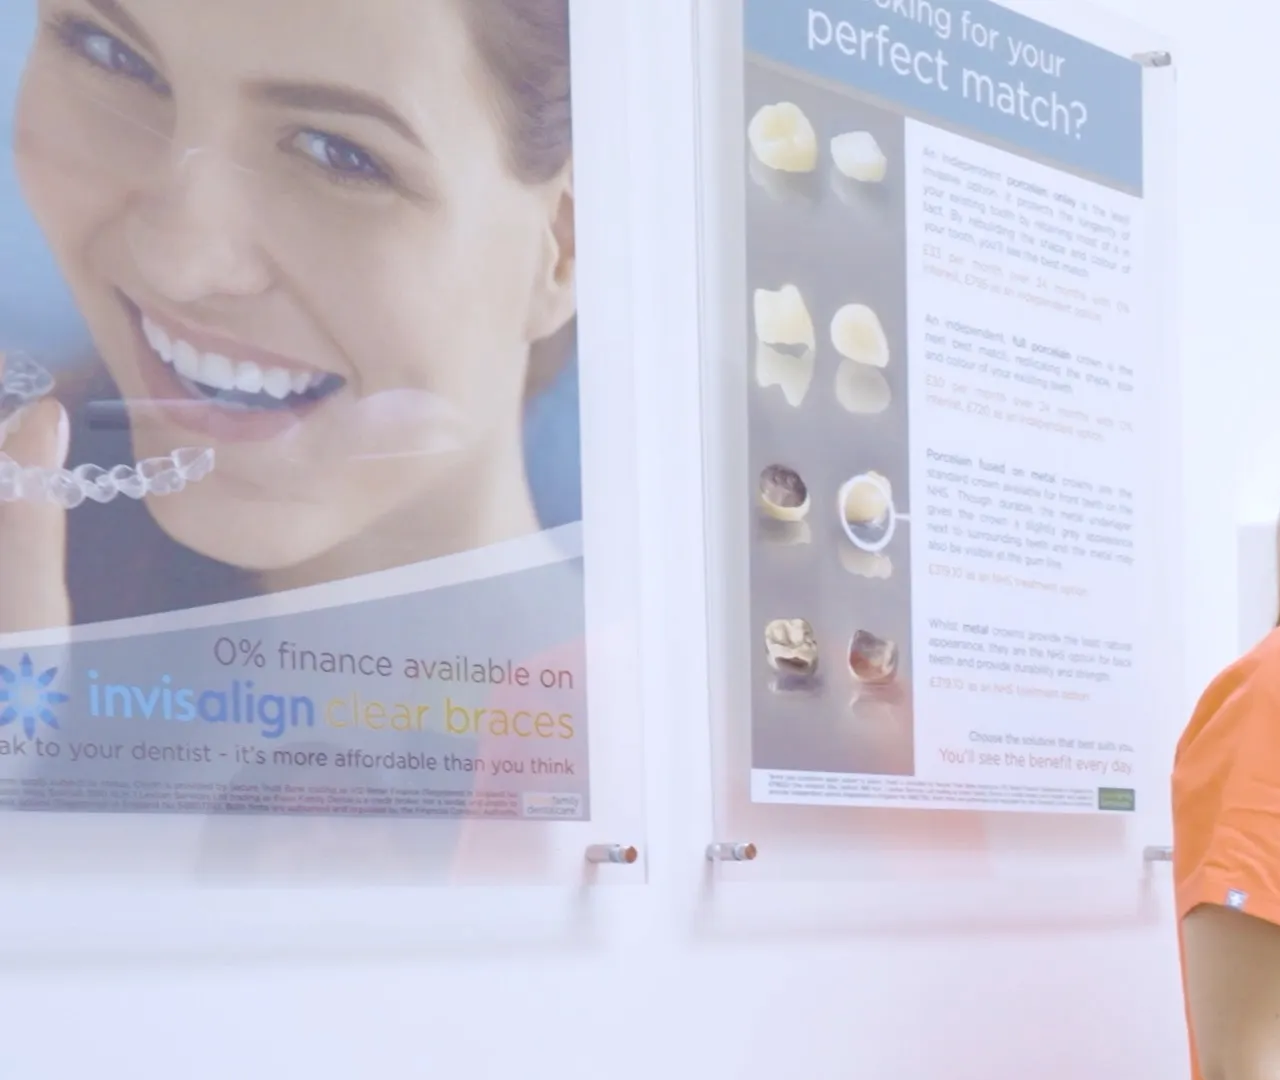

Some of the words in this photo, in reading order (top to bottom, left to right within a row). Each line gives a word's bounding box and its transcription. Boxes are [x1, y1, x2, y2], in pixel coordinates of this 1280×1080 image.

[961, 10, 999, 51] for
[1007, 35, 1066, 77] your
[807, 8, 949, 91] perfect
[962, 66, 1088, 140] match?
[214, 637, 266, 668] 0%
[278, 641, 392, 677] finance
[404, 655, 530, 686] available
[540, 668, 574, 689] on
[87, 669, 315, 739] invisalign
[324, 691, 430, 732] clear
[444, 696, 574, 740] braces
[35, 736, 60, 757] to
[68, 740, 124, 762] your
[131, 740, 212, 763] dentist
[235, 744, 266, 765] it's
[273, 749, 327, 767] more
[334, 748, 437, 772] affordable
[444, 753, 485, 772] than
[491, 759, 524, 776] you
[531, 757, 575, 775] think
[938, 746, 975, 764] You'll
[979, 753, 1001, 767] see
[1004, 751, 1025, 767] the
[1028, 753, 1072, 770] benefit
[1076, 760, 1109, 775] every
